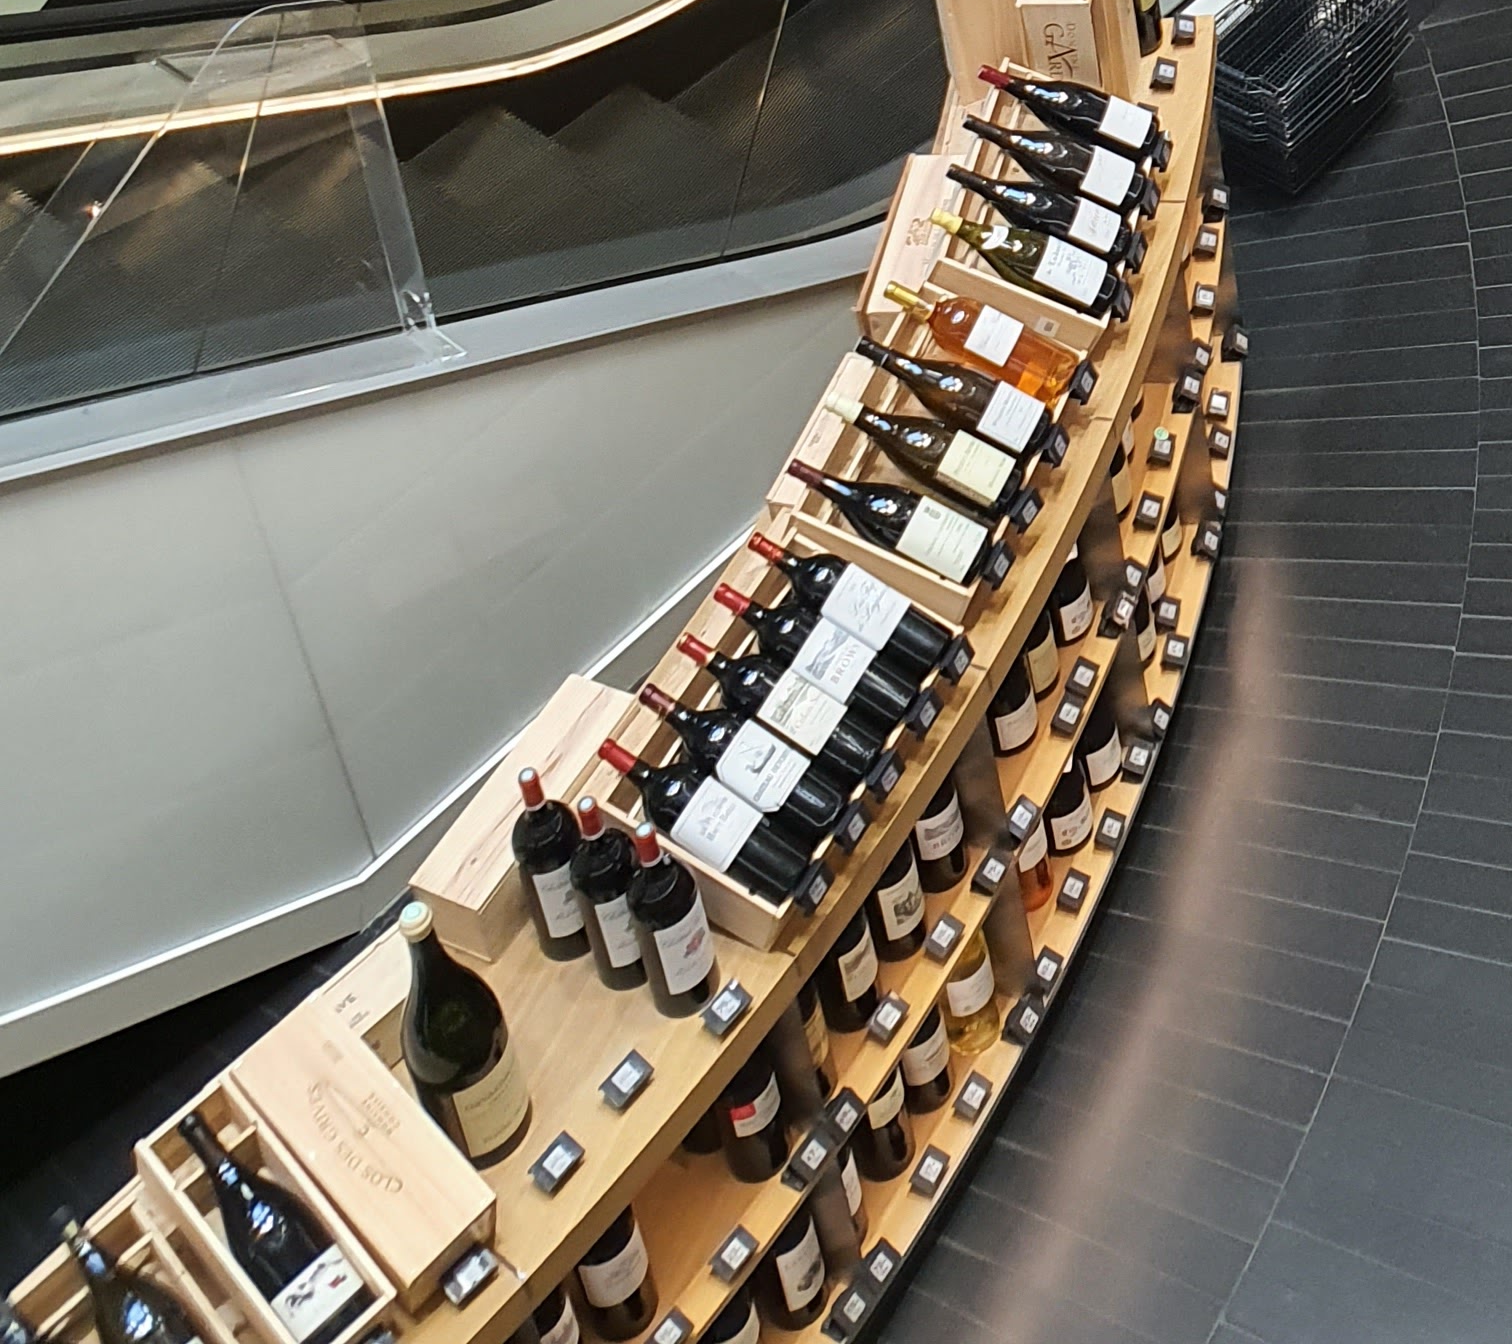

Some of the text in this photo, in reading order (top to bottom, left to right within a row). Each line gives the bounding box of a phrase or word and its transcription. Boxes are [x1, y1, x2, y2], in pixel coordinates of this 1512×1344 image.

[307, 1080, 404, 1194] CLOS DES GRIVES
